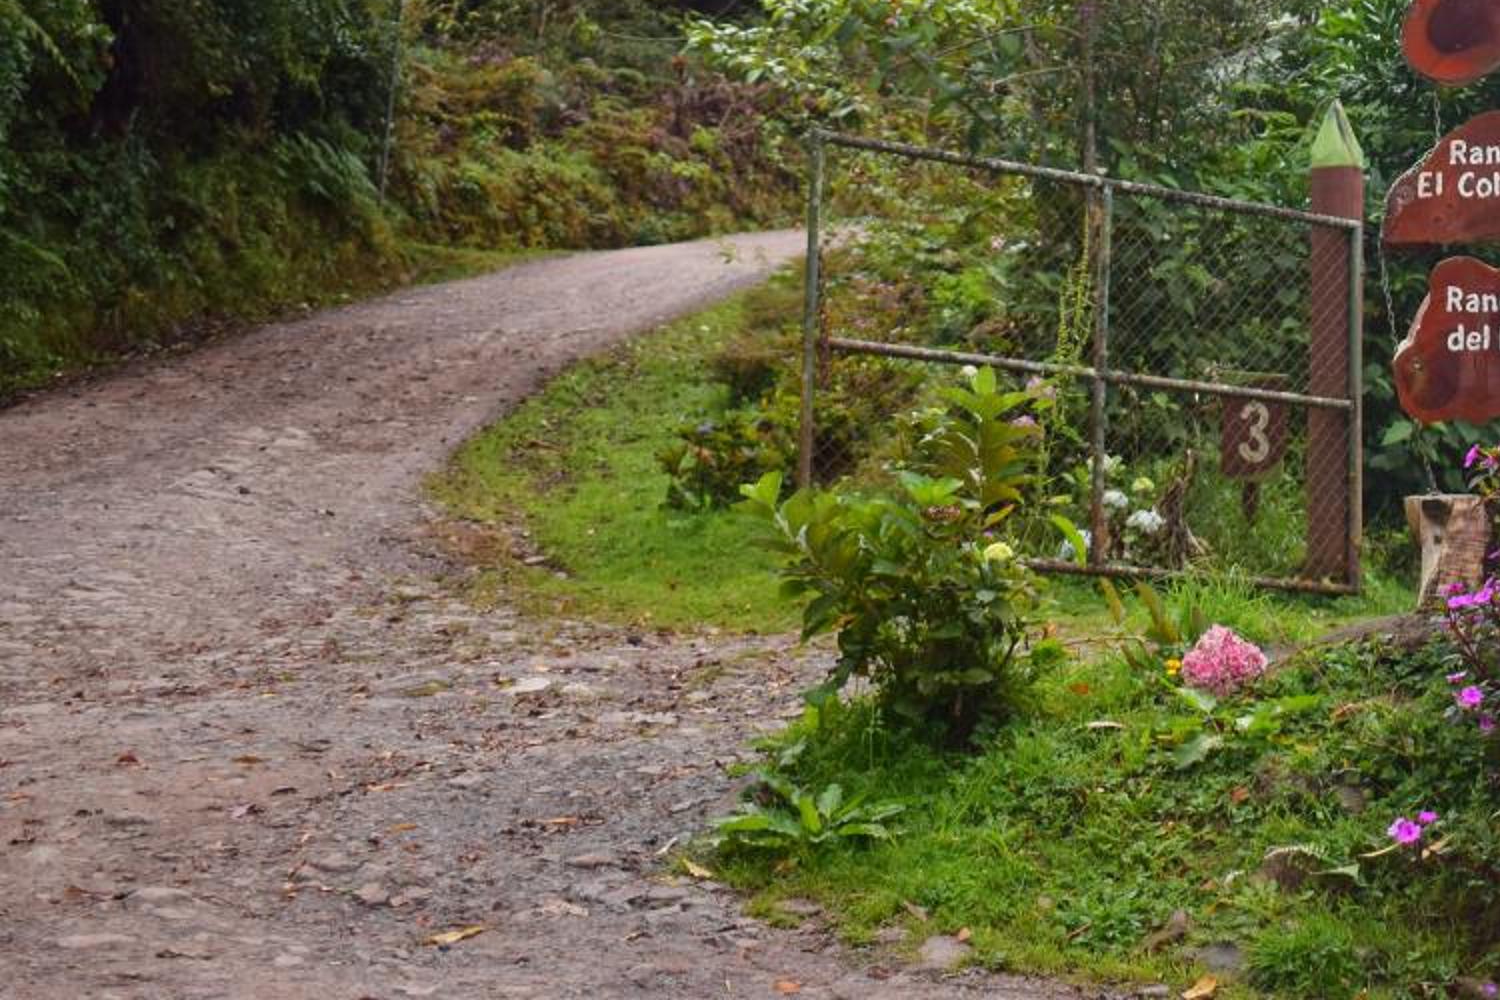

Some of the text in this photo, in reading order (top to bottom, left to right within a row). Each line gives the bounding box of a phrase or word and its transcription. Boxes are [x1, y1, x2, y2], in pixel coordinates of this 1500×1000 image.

[1417, 171, 1443, 198] El
[1447, 324, 1491, 351] del
[1238, 401, 1270, 463] 3
